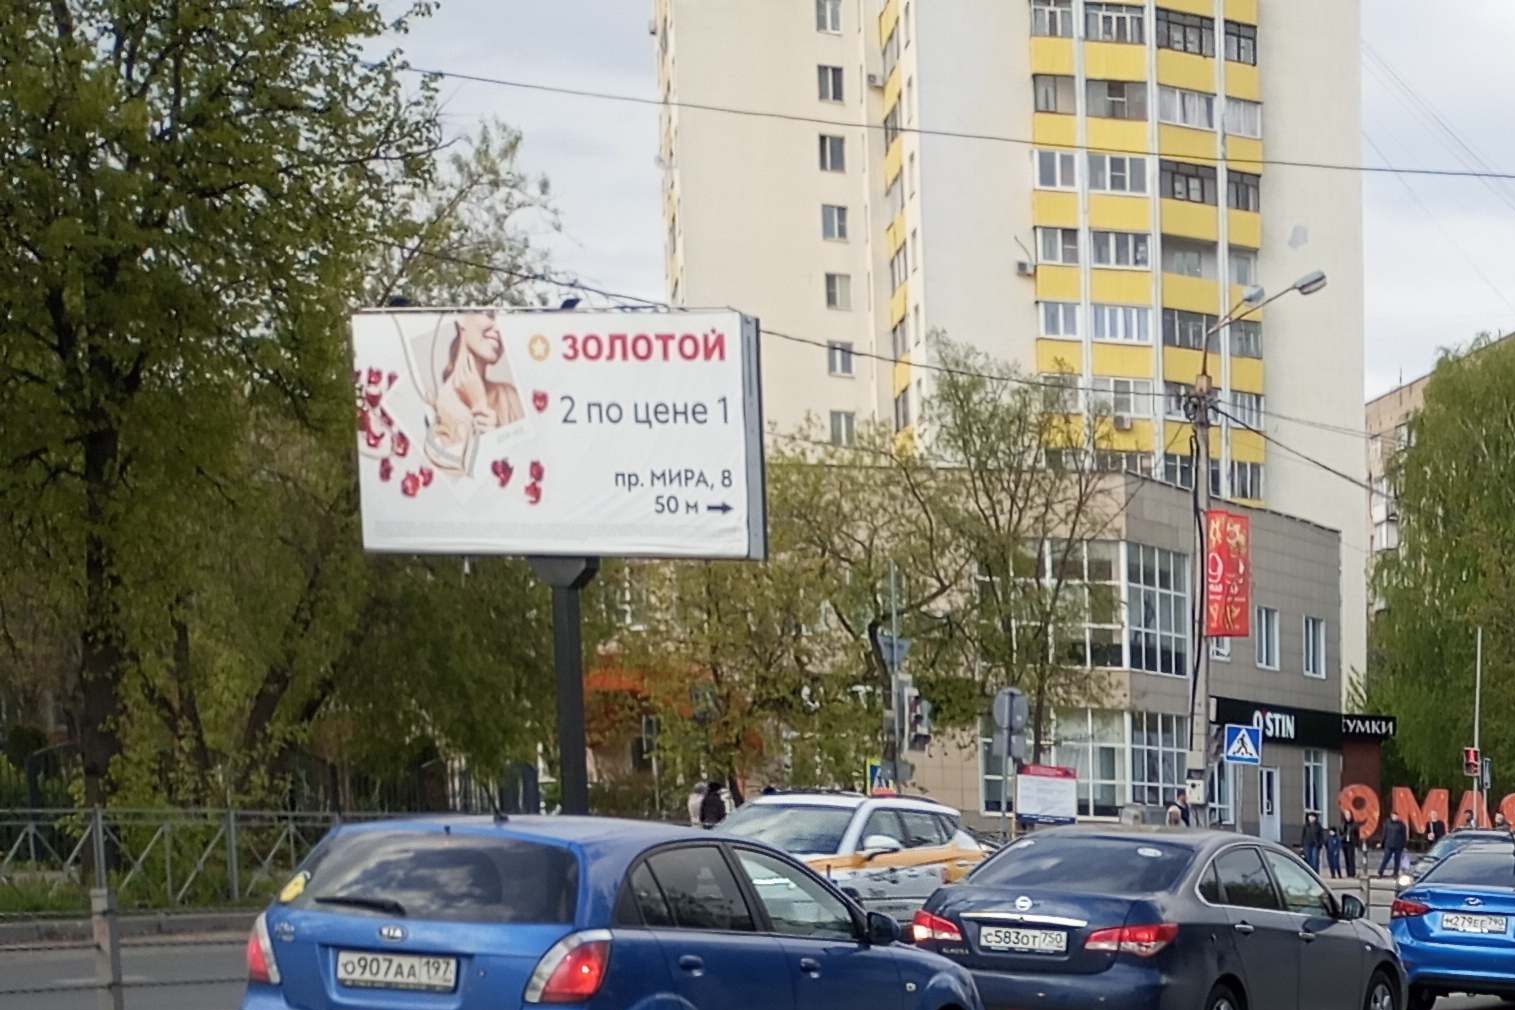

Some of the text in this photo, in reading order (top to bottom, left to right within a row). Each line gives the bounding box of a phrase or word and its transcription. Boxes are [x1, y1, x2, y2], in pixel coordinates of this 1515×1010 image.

[561, 328, 726, 361] ЗОЛОТОЙ
[560, 395, 729, 428] 2 по цене 1
[614, 469, 733, 491] пр. МИРА, 8
[654, 495, 699, 514] 50 м
[1338, 783, 1380, 841] 9
[1041, 932, 1062, 944] 750
[342, 957, 451, 979] О907АА 197
